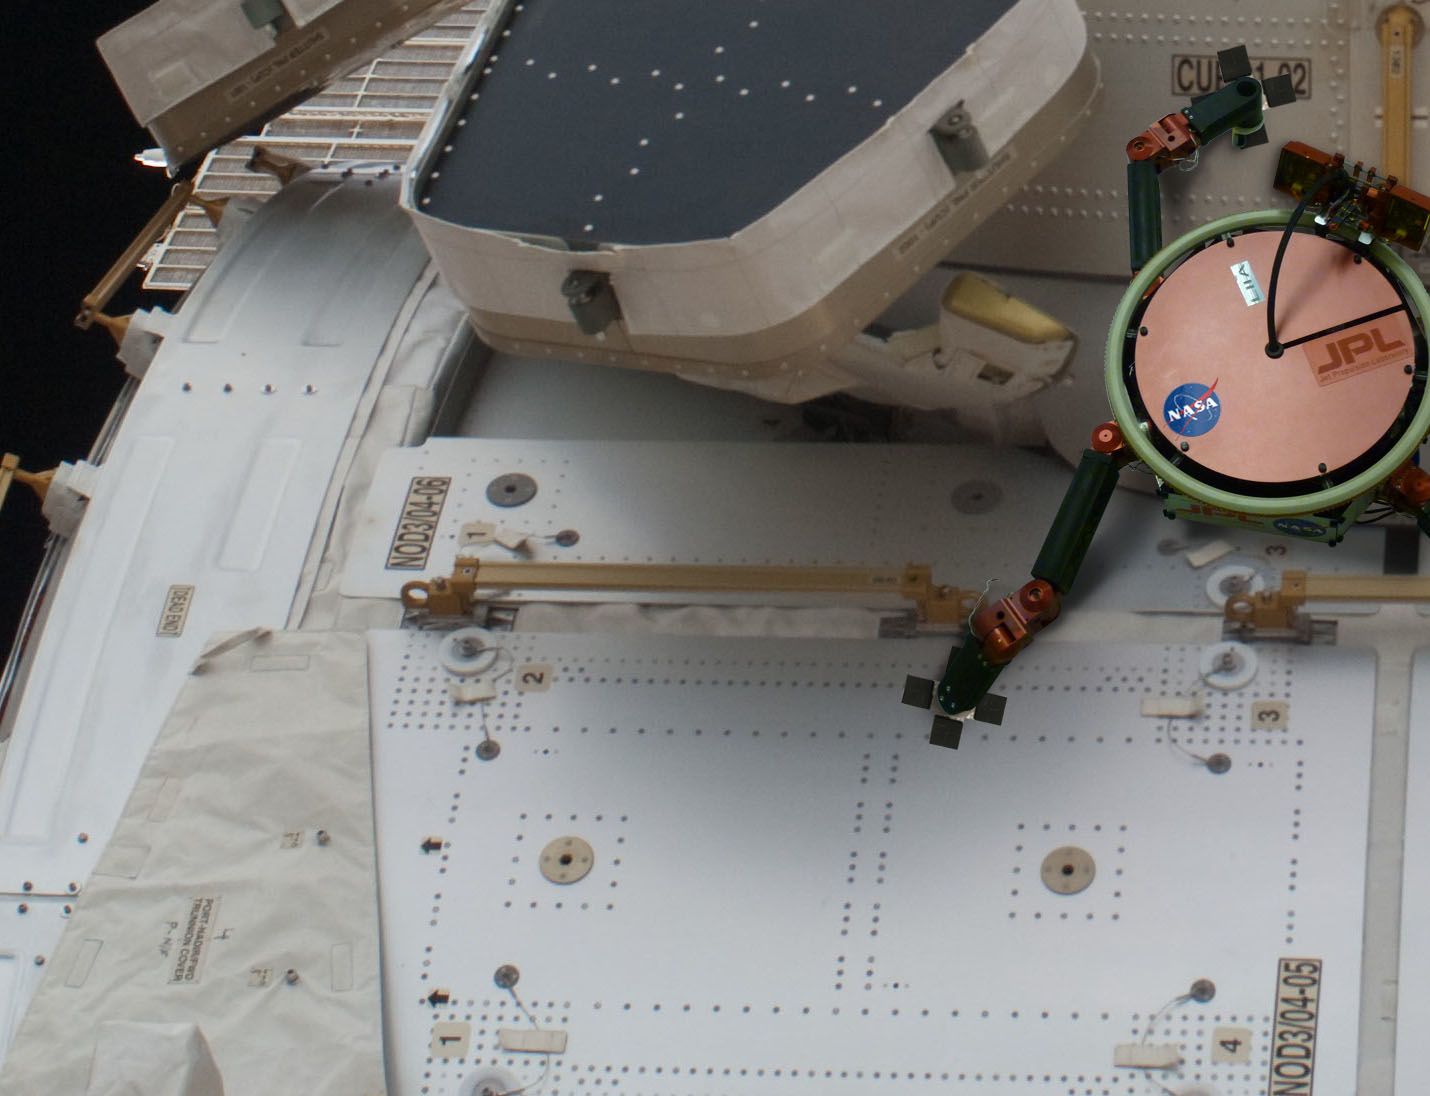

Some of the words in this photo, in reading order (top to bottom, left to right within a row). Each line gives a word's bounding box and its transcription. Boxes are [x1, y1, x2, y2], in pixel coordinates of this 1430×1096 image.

[1318, 327, 1407, 374] JPL
[1167, 395, 1219, 423] NASA
[388, 478, 449, 569] NOD3/04-06
[1278, 522, 1323, 534] NASA
[1265, 544, 1287, 556] 3
[163, 615, 182, 631] END
[522, 672, 544, 685] 2
[1258, 709, 1280, 722] 3
[182, 898, 203, 947] TRUNNION
[172, 948, 190, 982] COVER
[1273, 962, 1319, 1096] NOD3/04-05
[440, 1036, 462, 1046] 1
[1219, 1038, 1242, 1054] 4
